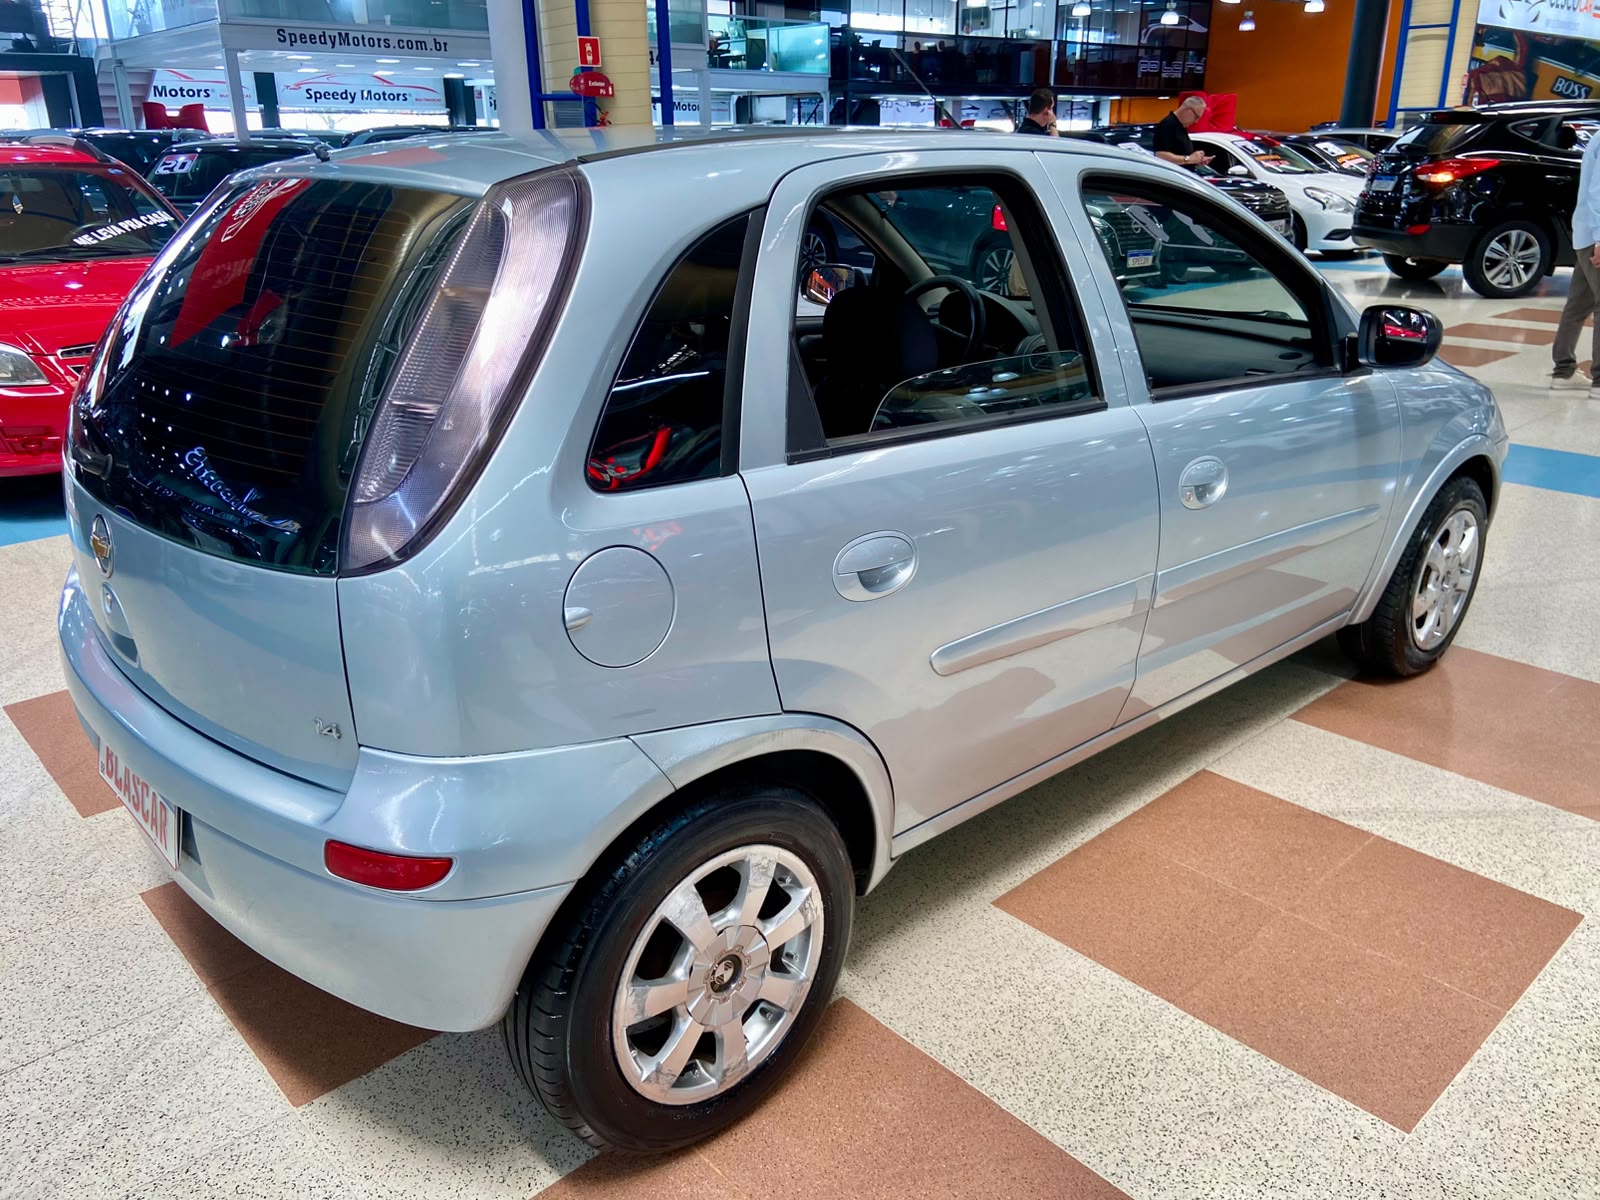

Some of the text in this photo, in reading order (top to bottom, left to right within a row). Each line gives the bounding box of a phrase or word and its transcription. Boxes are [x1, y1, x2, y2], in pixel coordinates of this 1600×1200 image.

[277, 28, 448, 52] SpeedyMotors.com.br
[153, 85, 211, 98] Motors
[305, 88, 408, 104] Speedy Motors
[1553, 77, 1590, 99] BOSS
[73, 234, 99, 245] ME
[90, 225, 126, 241] LEVA
[117, 218, 147, 232] PRA
[105, 745, 168, 851] BLASCAR
